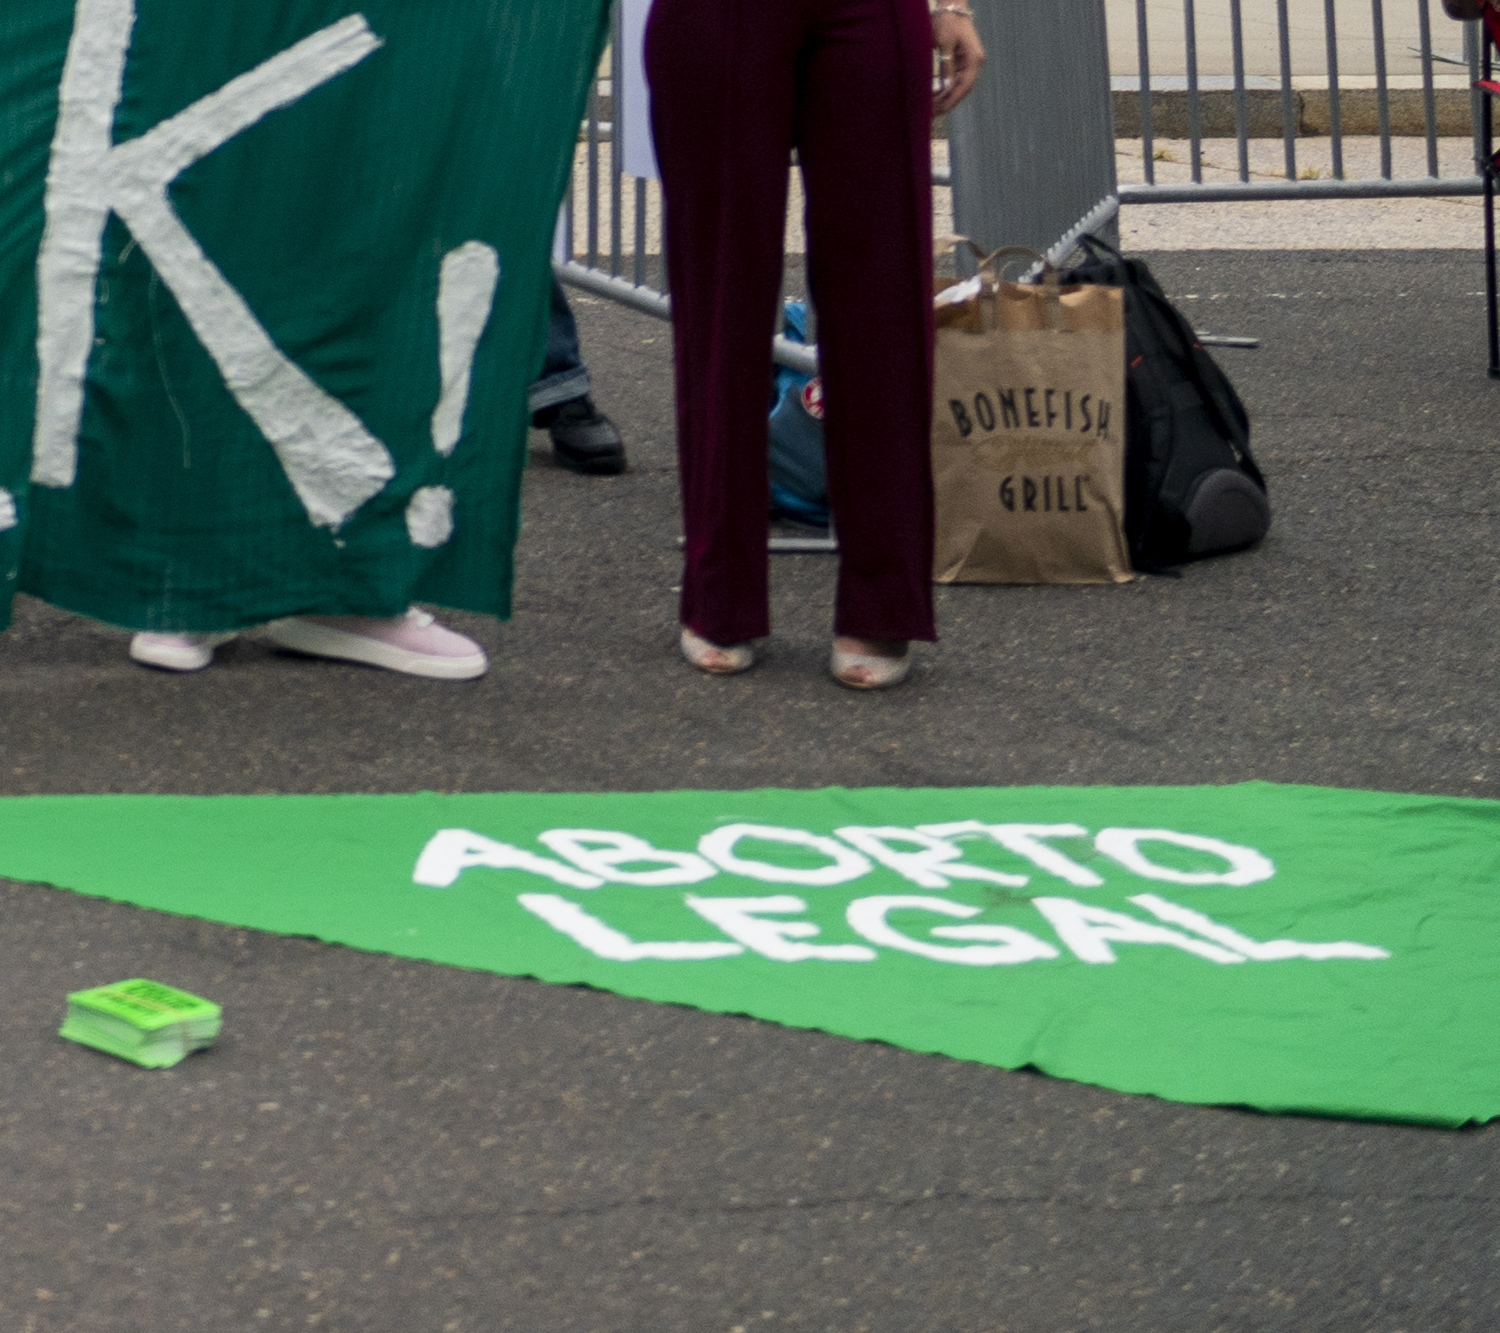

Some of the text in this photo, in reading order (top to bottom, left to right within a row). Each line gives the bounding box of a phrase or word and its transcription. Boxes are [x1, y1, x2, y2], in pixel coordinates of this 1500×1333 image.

[949, 388, 1112, 439] BONEFISH
[1000, 475, 1088, 512] GRILL
[412, 820, 1275, 889] ABORTO
[517, 891, 1391, 966] LEGAL
